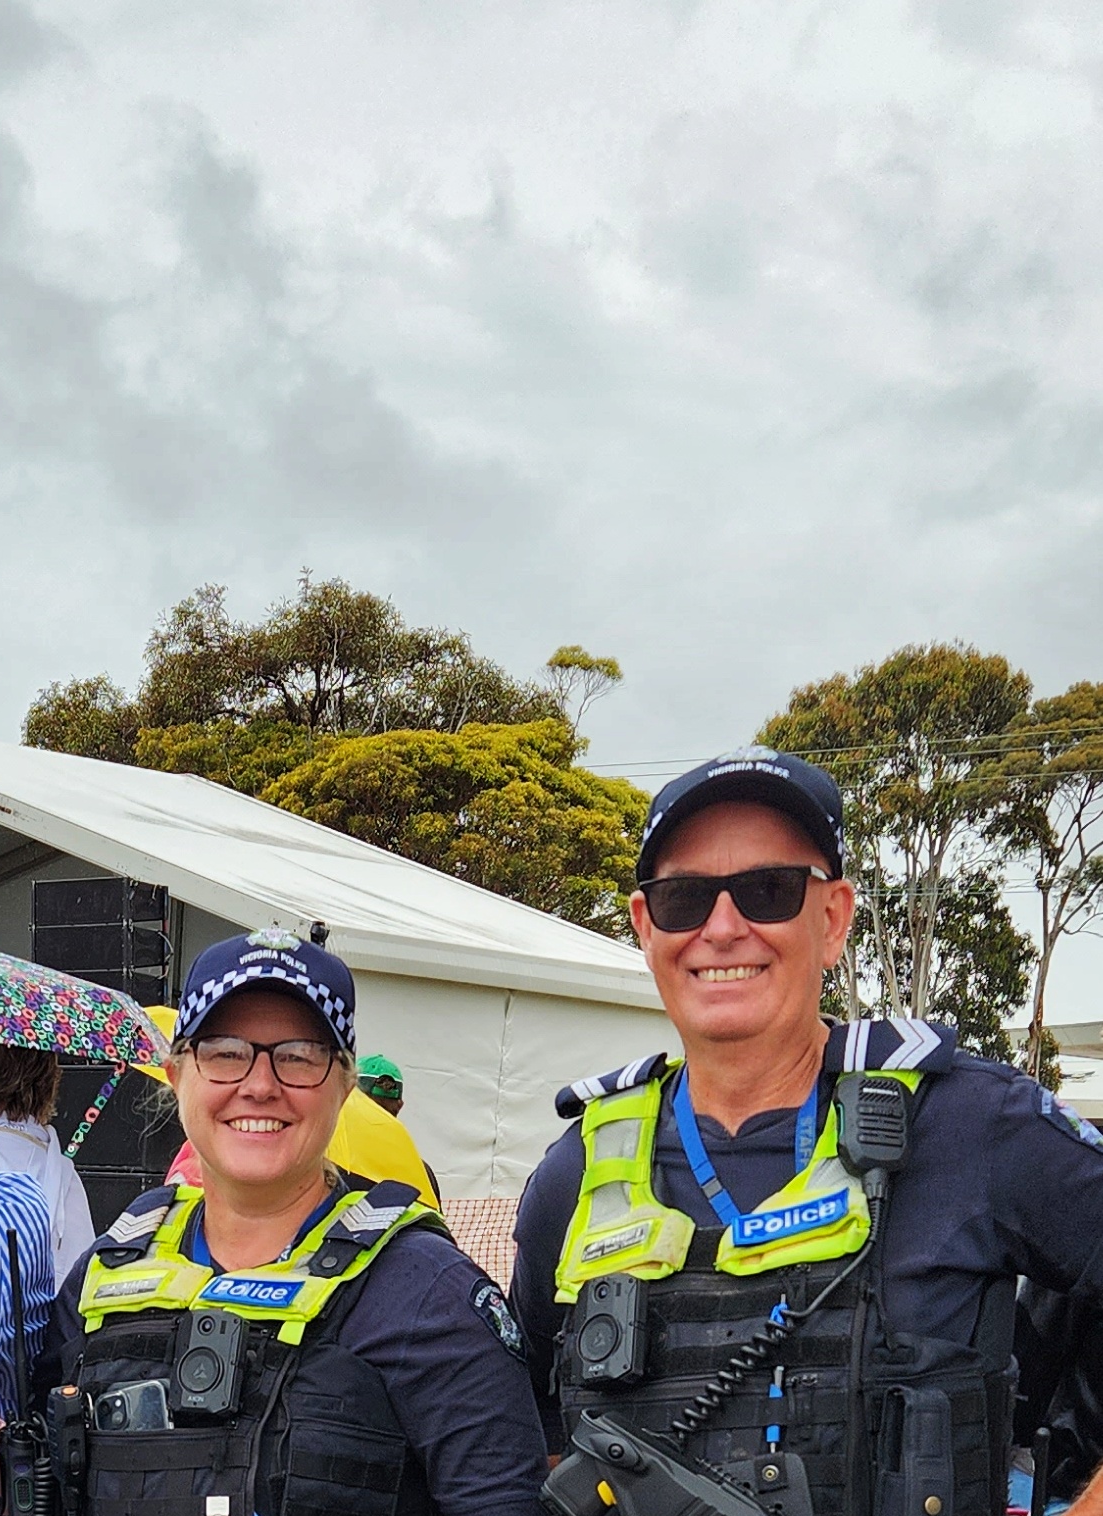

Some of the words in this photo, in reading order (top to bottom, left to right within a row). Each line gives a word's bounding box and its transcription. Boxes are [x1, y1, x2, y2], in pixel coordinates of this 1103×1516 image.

[239, 949, 278, 965] VICTORIA
[743, 1201, 836, 1236] Police
[213, 1280, 288, 1300] Police
